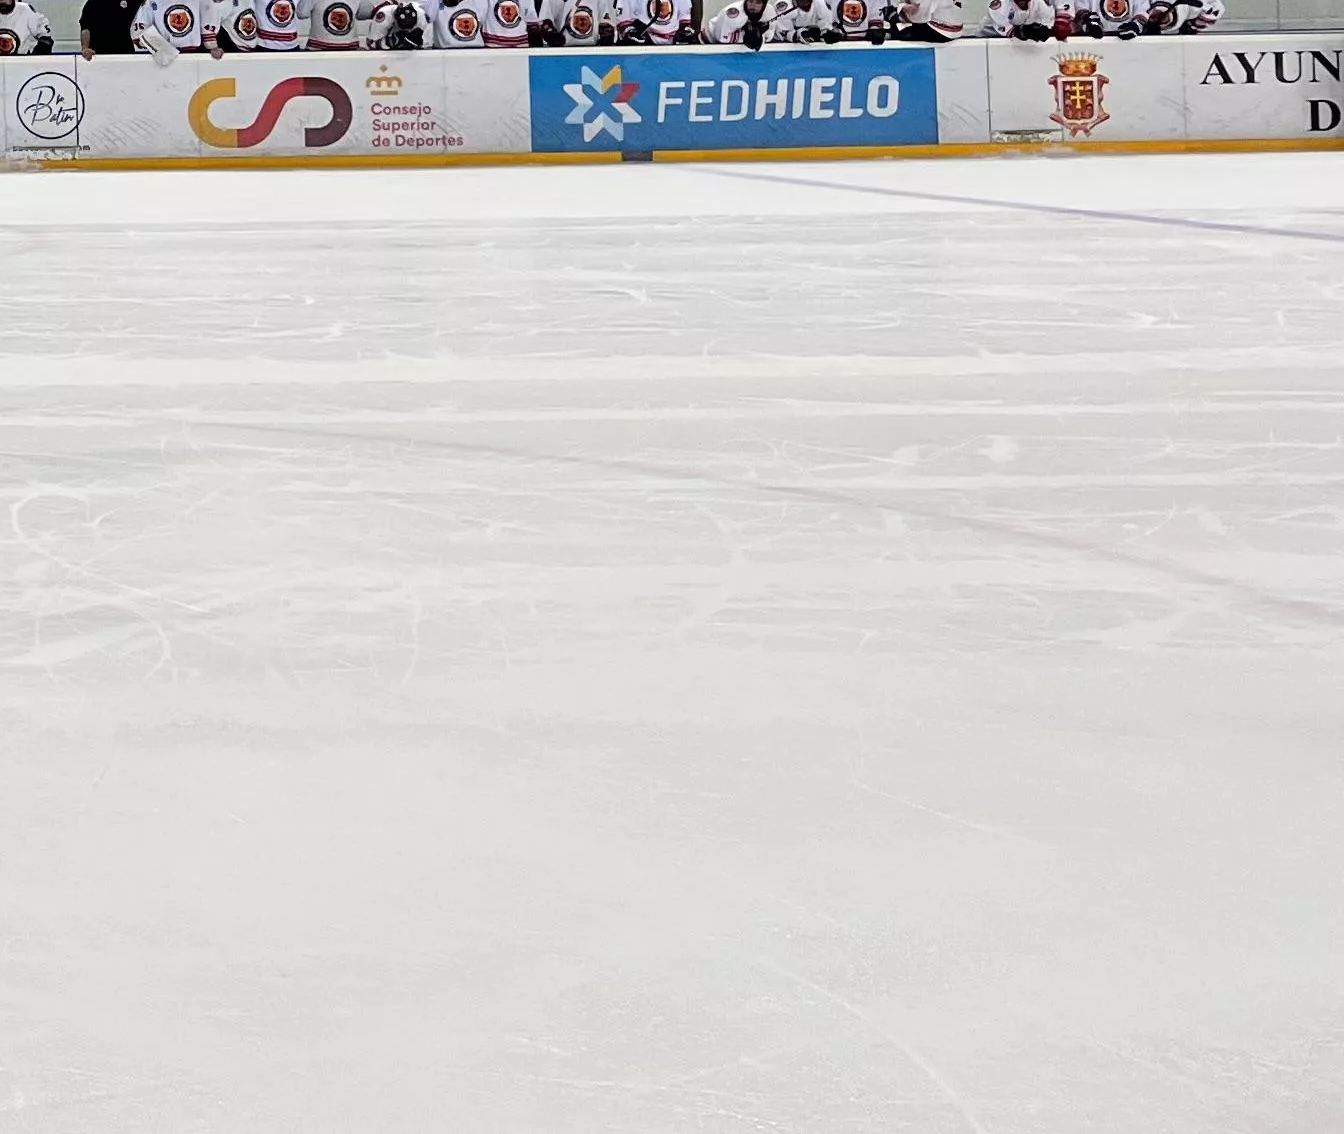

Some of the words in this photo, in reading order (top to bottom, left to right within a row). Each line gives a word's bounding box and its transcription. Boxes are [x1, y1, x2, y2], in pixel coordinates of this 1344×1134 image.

[657, 74, 900, 124] FEDHIELO
[370, 102, 432, 117] Consejo
[372, 118, 437, 134] Superior
[371, 135, 391, 147] de
[395, 134, 464, 150] Deportes
